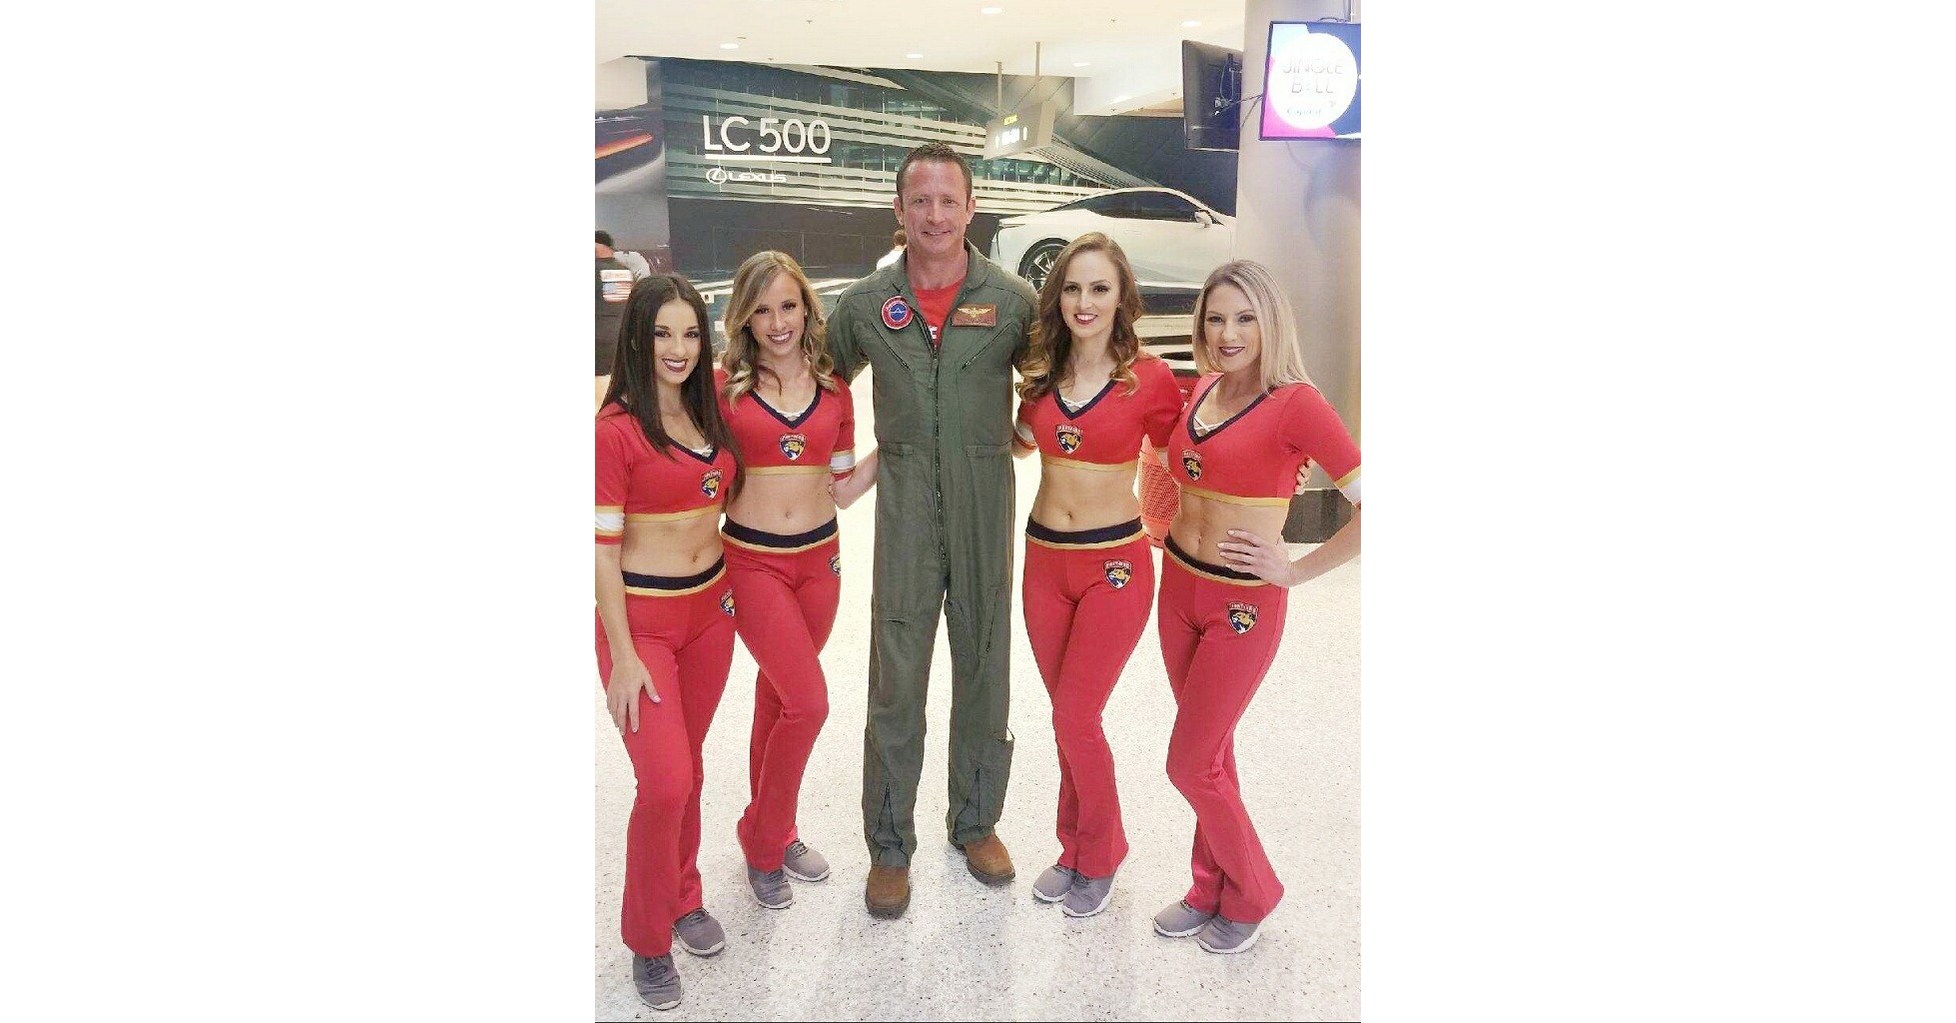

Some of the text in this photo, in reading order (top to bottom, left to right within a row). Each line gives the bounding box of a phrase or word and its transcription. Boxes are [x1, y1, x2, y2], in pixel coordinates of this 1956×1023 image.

[1291, 77, 1334, 93] BLL
[703, 115, 831, 154] LC 500
[729, 171, 787, 183] LEXUS
